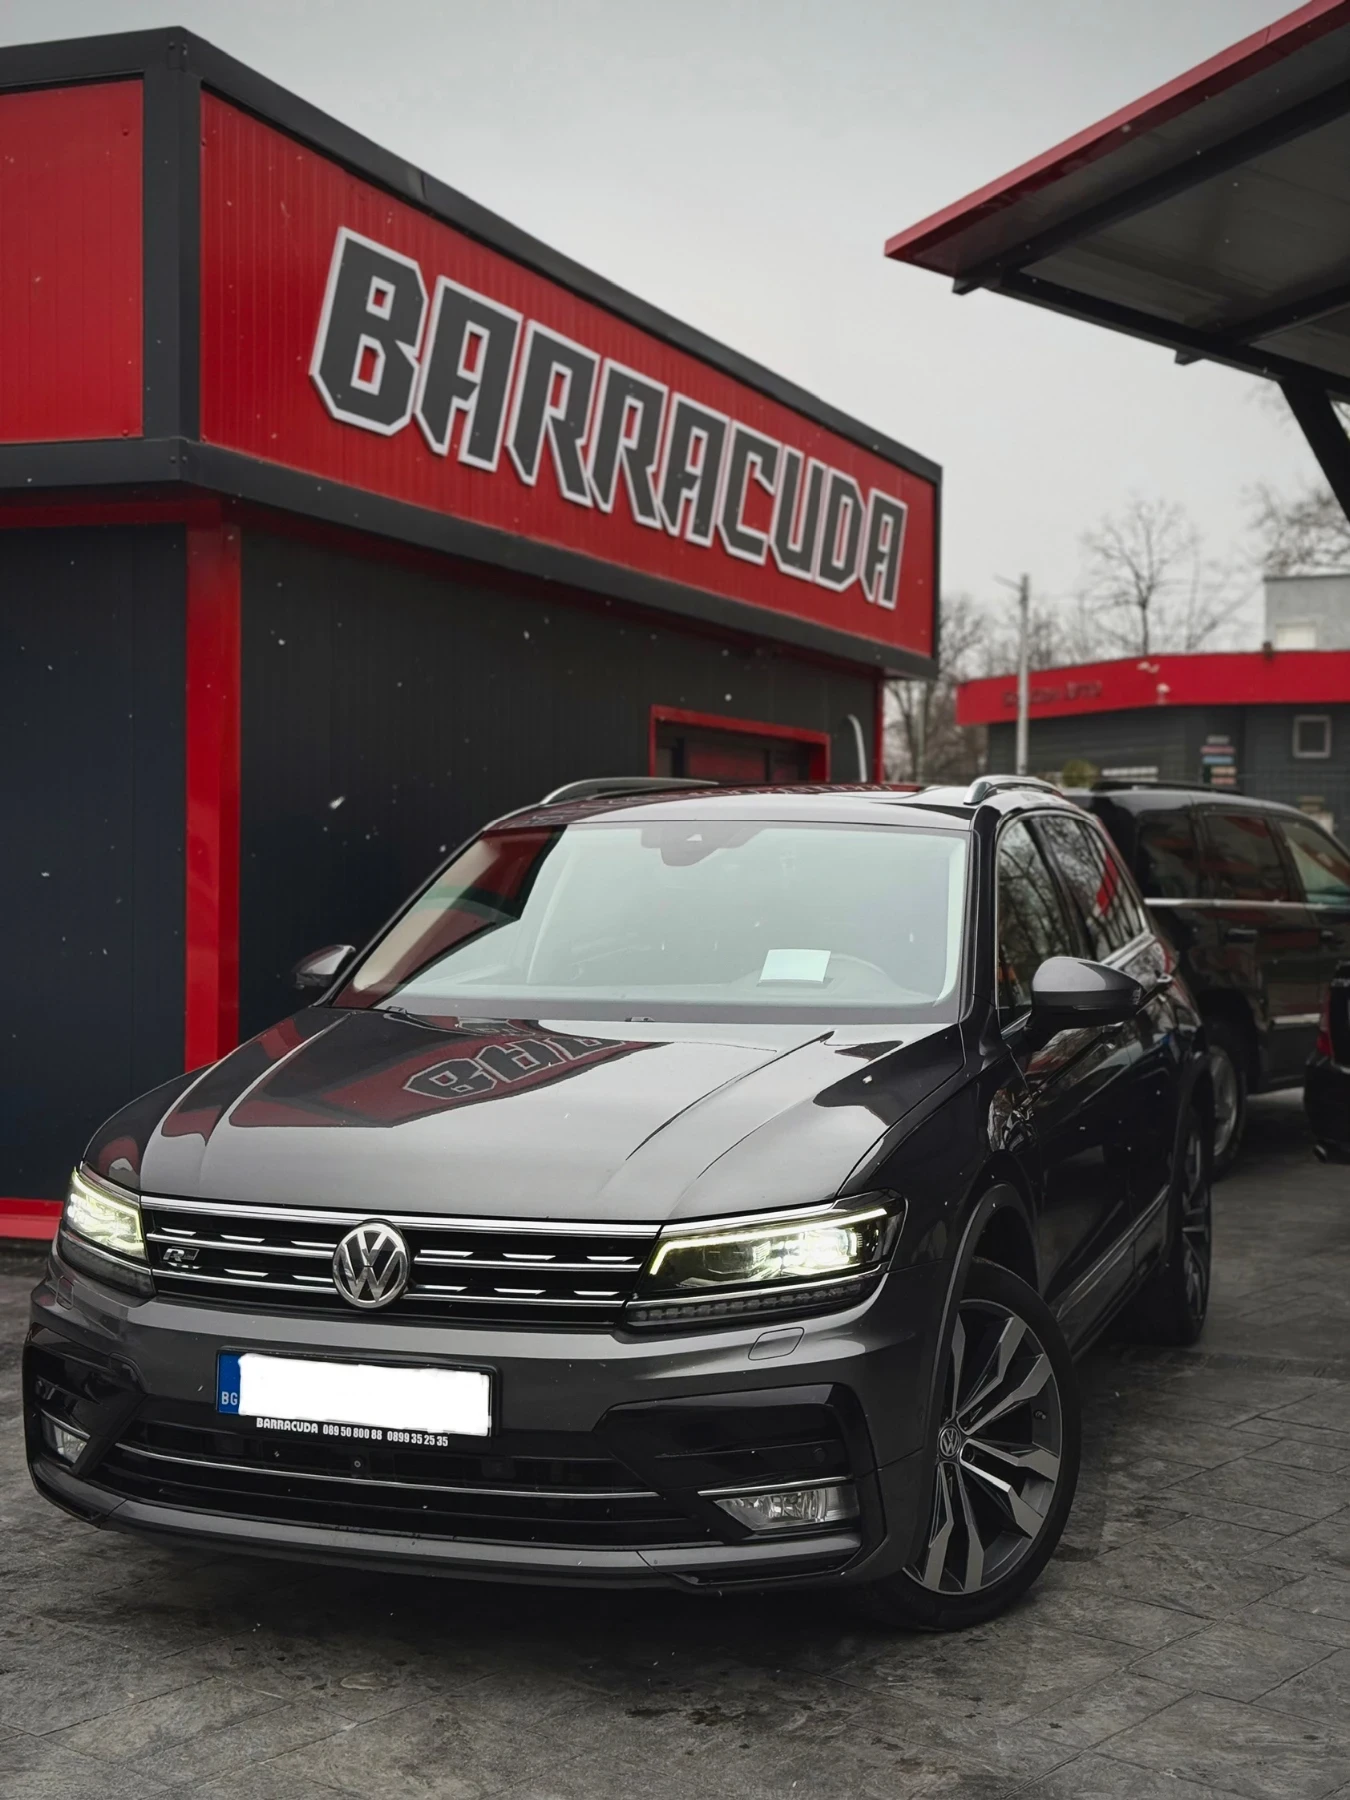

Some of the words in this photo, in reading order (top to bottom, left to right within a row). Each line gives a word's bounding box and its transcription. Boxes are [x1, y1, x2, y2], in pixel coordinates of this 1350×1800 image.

[309, 226, 907, 610] BARRACUDA
[337, 1225, 404, 1303] VW
[221, 1391, 238, 1406] BG
[256, 1417, 319, 1434] BARRACUDA
[323, 1424, 340, 1436] 089
[340, 1426, 352, 1437] 50
[353, 1427, 370, 1439] 800
[371, 1429, 382, 1440] 88
[387, 1430, 410, 1443] 0899
[411, 1433, 422, 1444] 35
[424, 1434, 435, 1446] 25
[437, 1436, 448, 1447] 35
